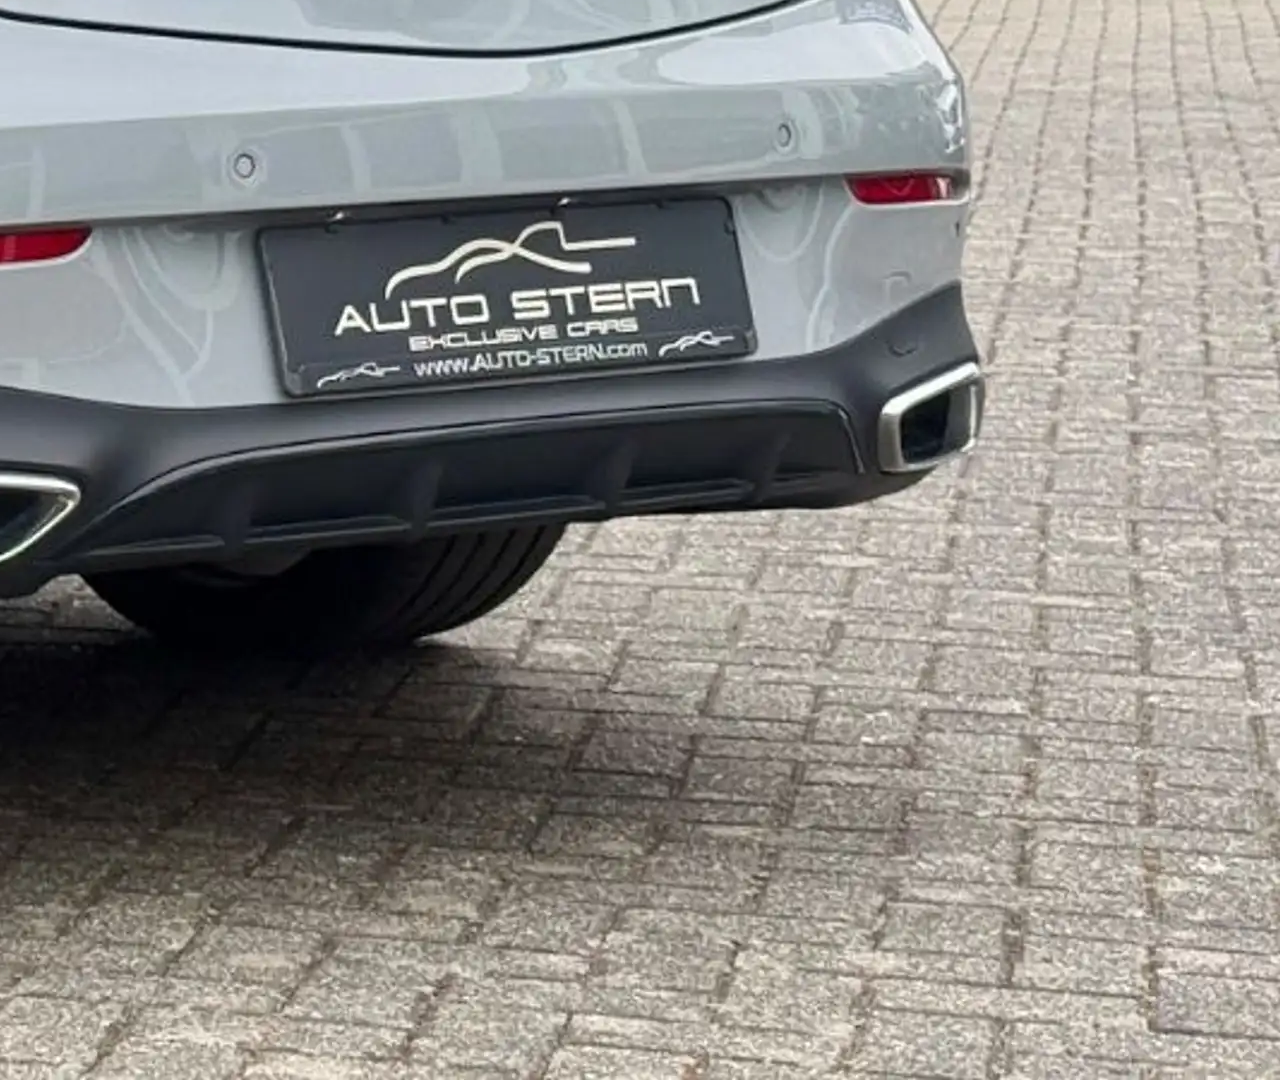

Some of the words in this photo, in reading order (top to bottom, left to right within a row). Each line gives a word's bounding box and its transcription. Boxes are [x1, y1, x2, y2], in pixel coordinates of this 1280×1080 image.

[335, 294, 490, 335] AUTO
[512, 277, 700, 320] STERN
[408, 324, 558, 352] EXCLUSIVE
[566, 317, 639, 335] CARS
[413, 340, 649, 378] www.AUTO-STERN.com
